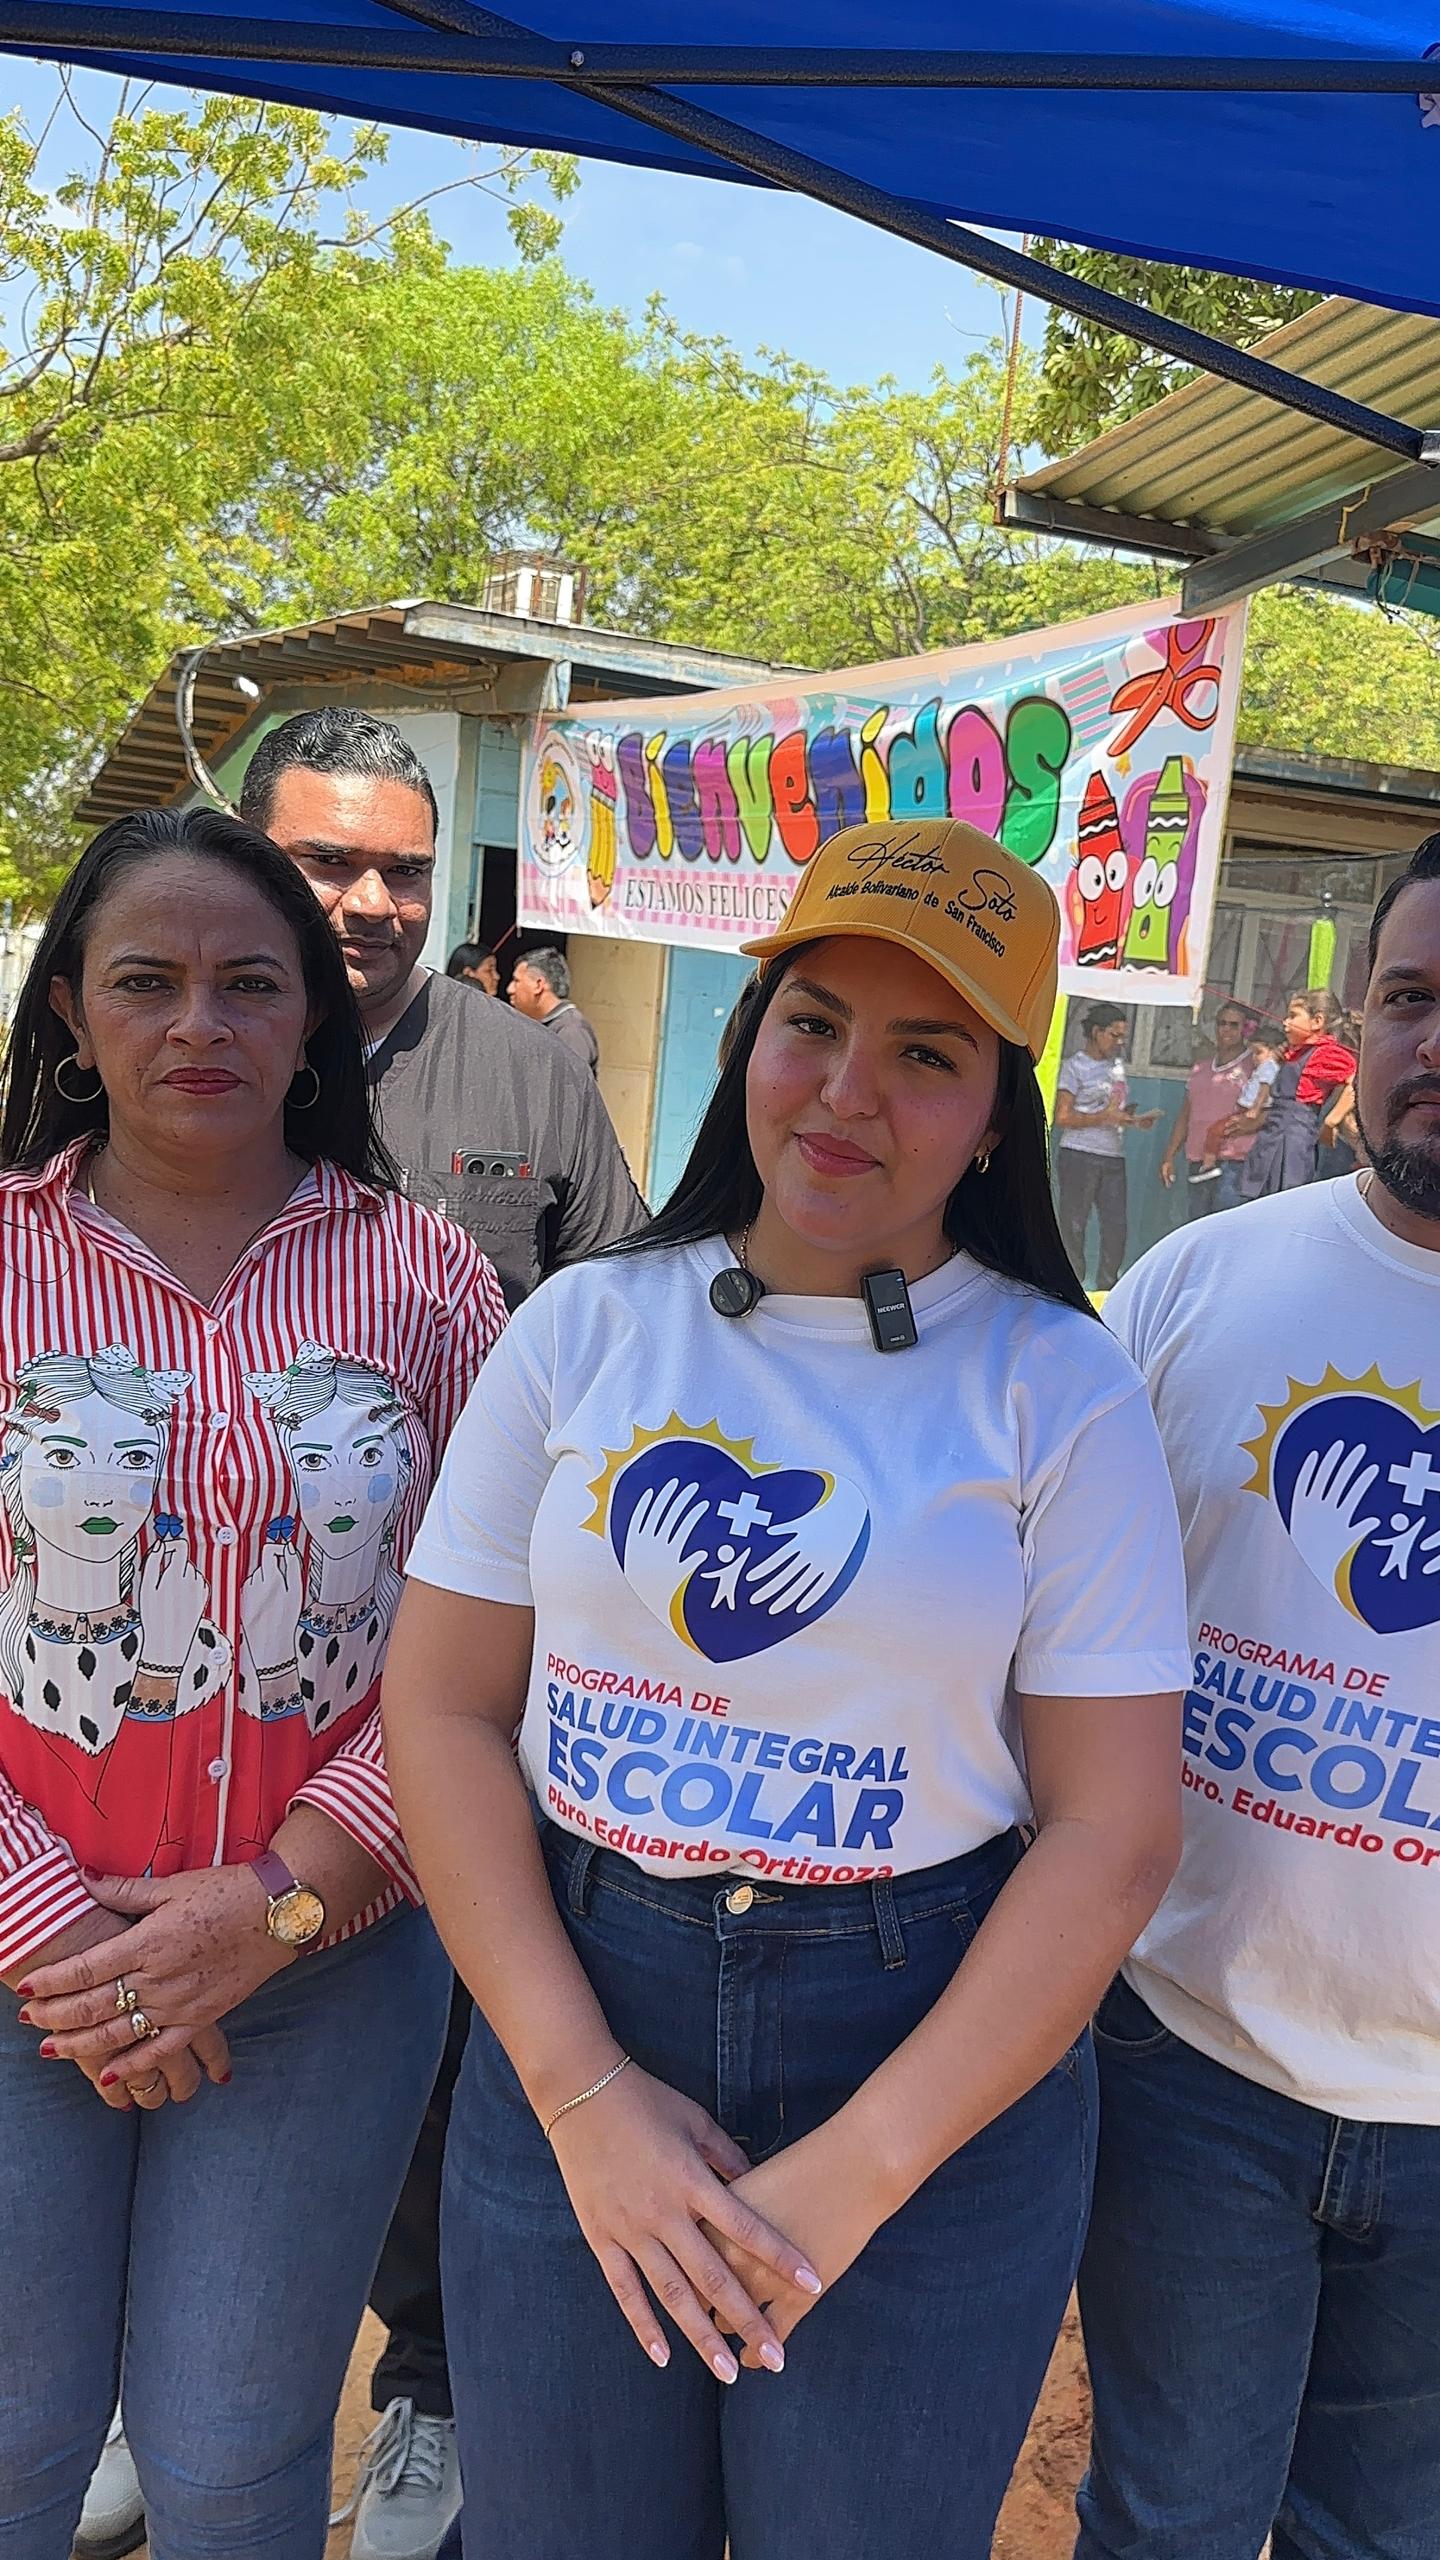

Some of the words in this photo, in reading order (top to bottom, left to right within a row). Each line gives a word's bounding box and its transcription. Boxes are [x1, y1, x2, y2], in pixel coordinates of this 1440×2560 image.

[625, 879, 704, 915] ESTAMOS
[709, 884, 788, 921] FELICES
[825, 881, 860, 901] Alcalde
[860, 880, 919, 901] Bolivariano
[923, 890, 939, 908] de
[944, 900, 965, 923] San
[966, 913, 1005, 958] Francisco
[957, 868, 1018, 922] Soto
[877, 1302, 905, 1314] NEEWER
[547, 1652, 683, 1708] PROGRAMA
[690, 1692, 731, 1718] DE
[1193, 1651, 1317, 1722] SALUD
[1197, 1622, 1335, 1686] PROGRAMA
[1342, 1666, 1390, 1698] DE
[547, 1682, 668, 1745] SALUD
[673, 1716, 910, 1783] INTEGRAL
[1182, 1690, 1440, 1833] ESCOL
[548, 1718, 904, 1851] ESCOLAR
[548, 1784, 593, 1832] Pbro.
[594, 1816, 731, 1862] Eduardo
[1181, 1759, 1225, 1805] bro.
[1231, 1787, 1384, 1853] Eduardo
